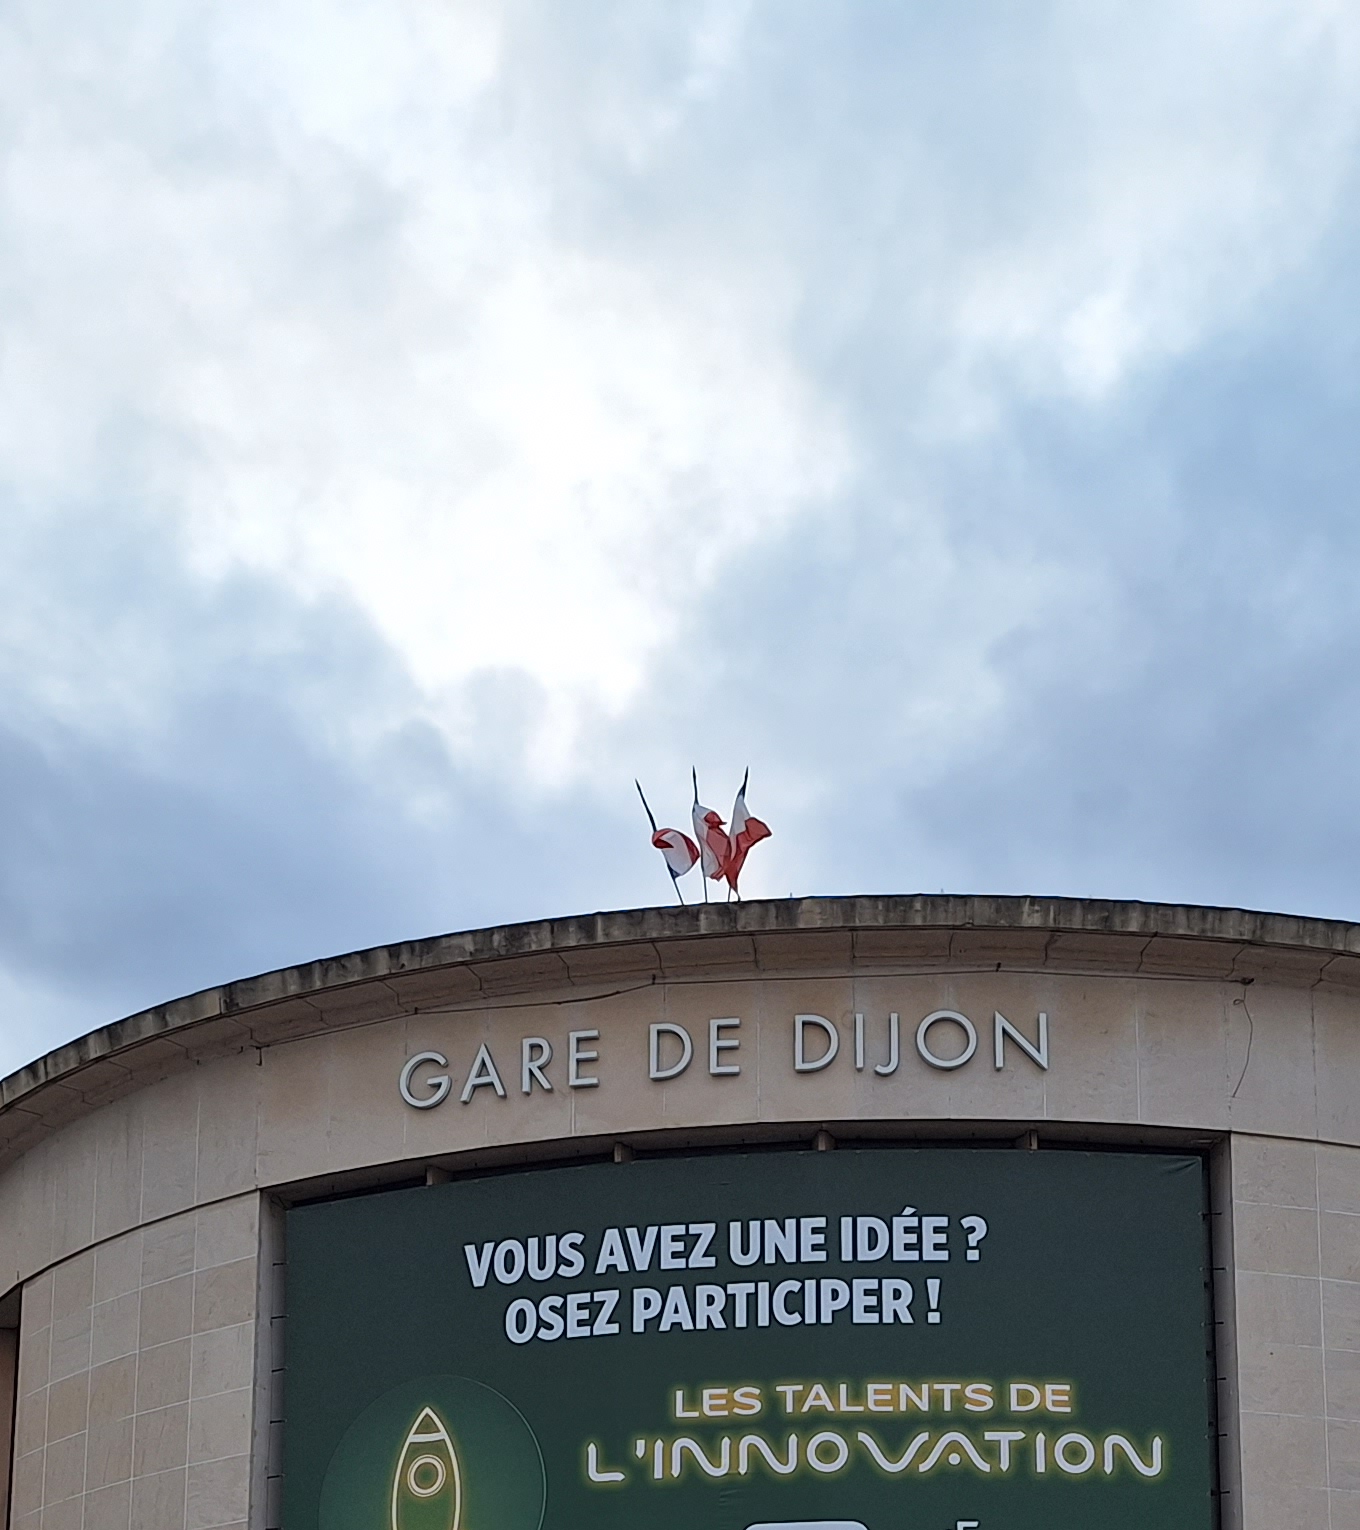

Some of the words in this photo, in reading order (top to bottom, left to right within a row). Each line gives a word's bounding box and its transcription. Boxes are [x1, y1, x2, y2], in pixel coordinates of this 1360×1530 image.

[398, 1029, 600, 1109] GARE
[649, 1018, 741, 1081] DE
[793, 1009, 1049, 1077] DIJON
[464, 1232, 586, 1288] VOUS
[594, 1222, 717, 1275] AVEZ
[729, 1216, 827, 1266] UNE
[840, 1206, 950, 1262] IDÉE
[505, 1289, 620, 1344] OSEZ
[632, 1278, 914, 1333] PARTICIPER
[675, 1387, 762, 1418] LES
[775, 1383, 994, 1413] TALENTS
[1009, 1383, 1072, 1413] DE
[588, 1431, 1162, 1483] L'INNOVATION
